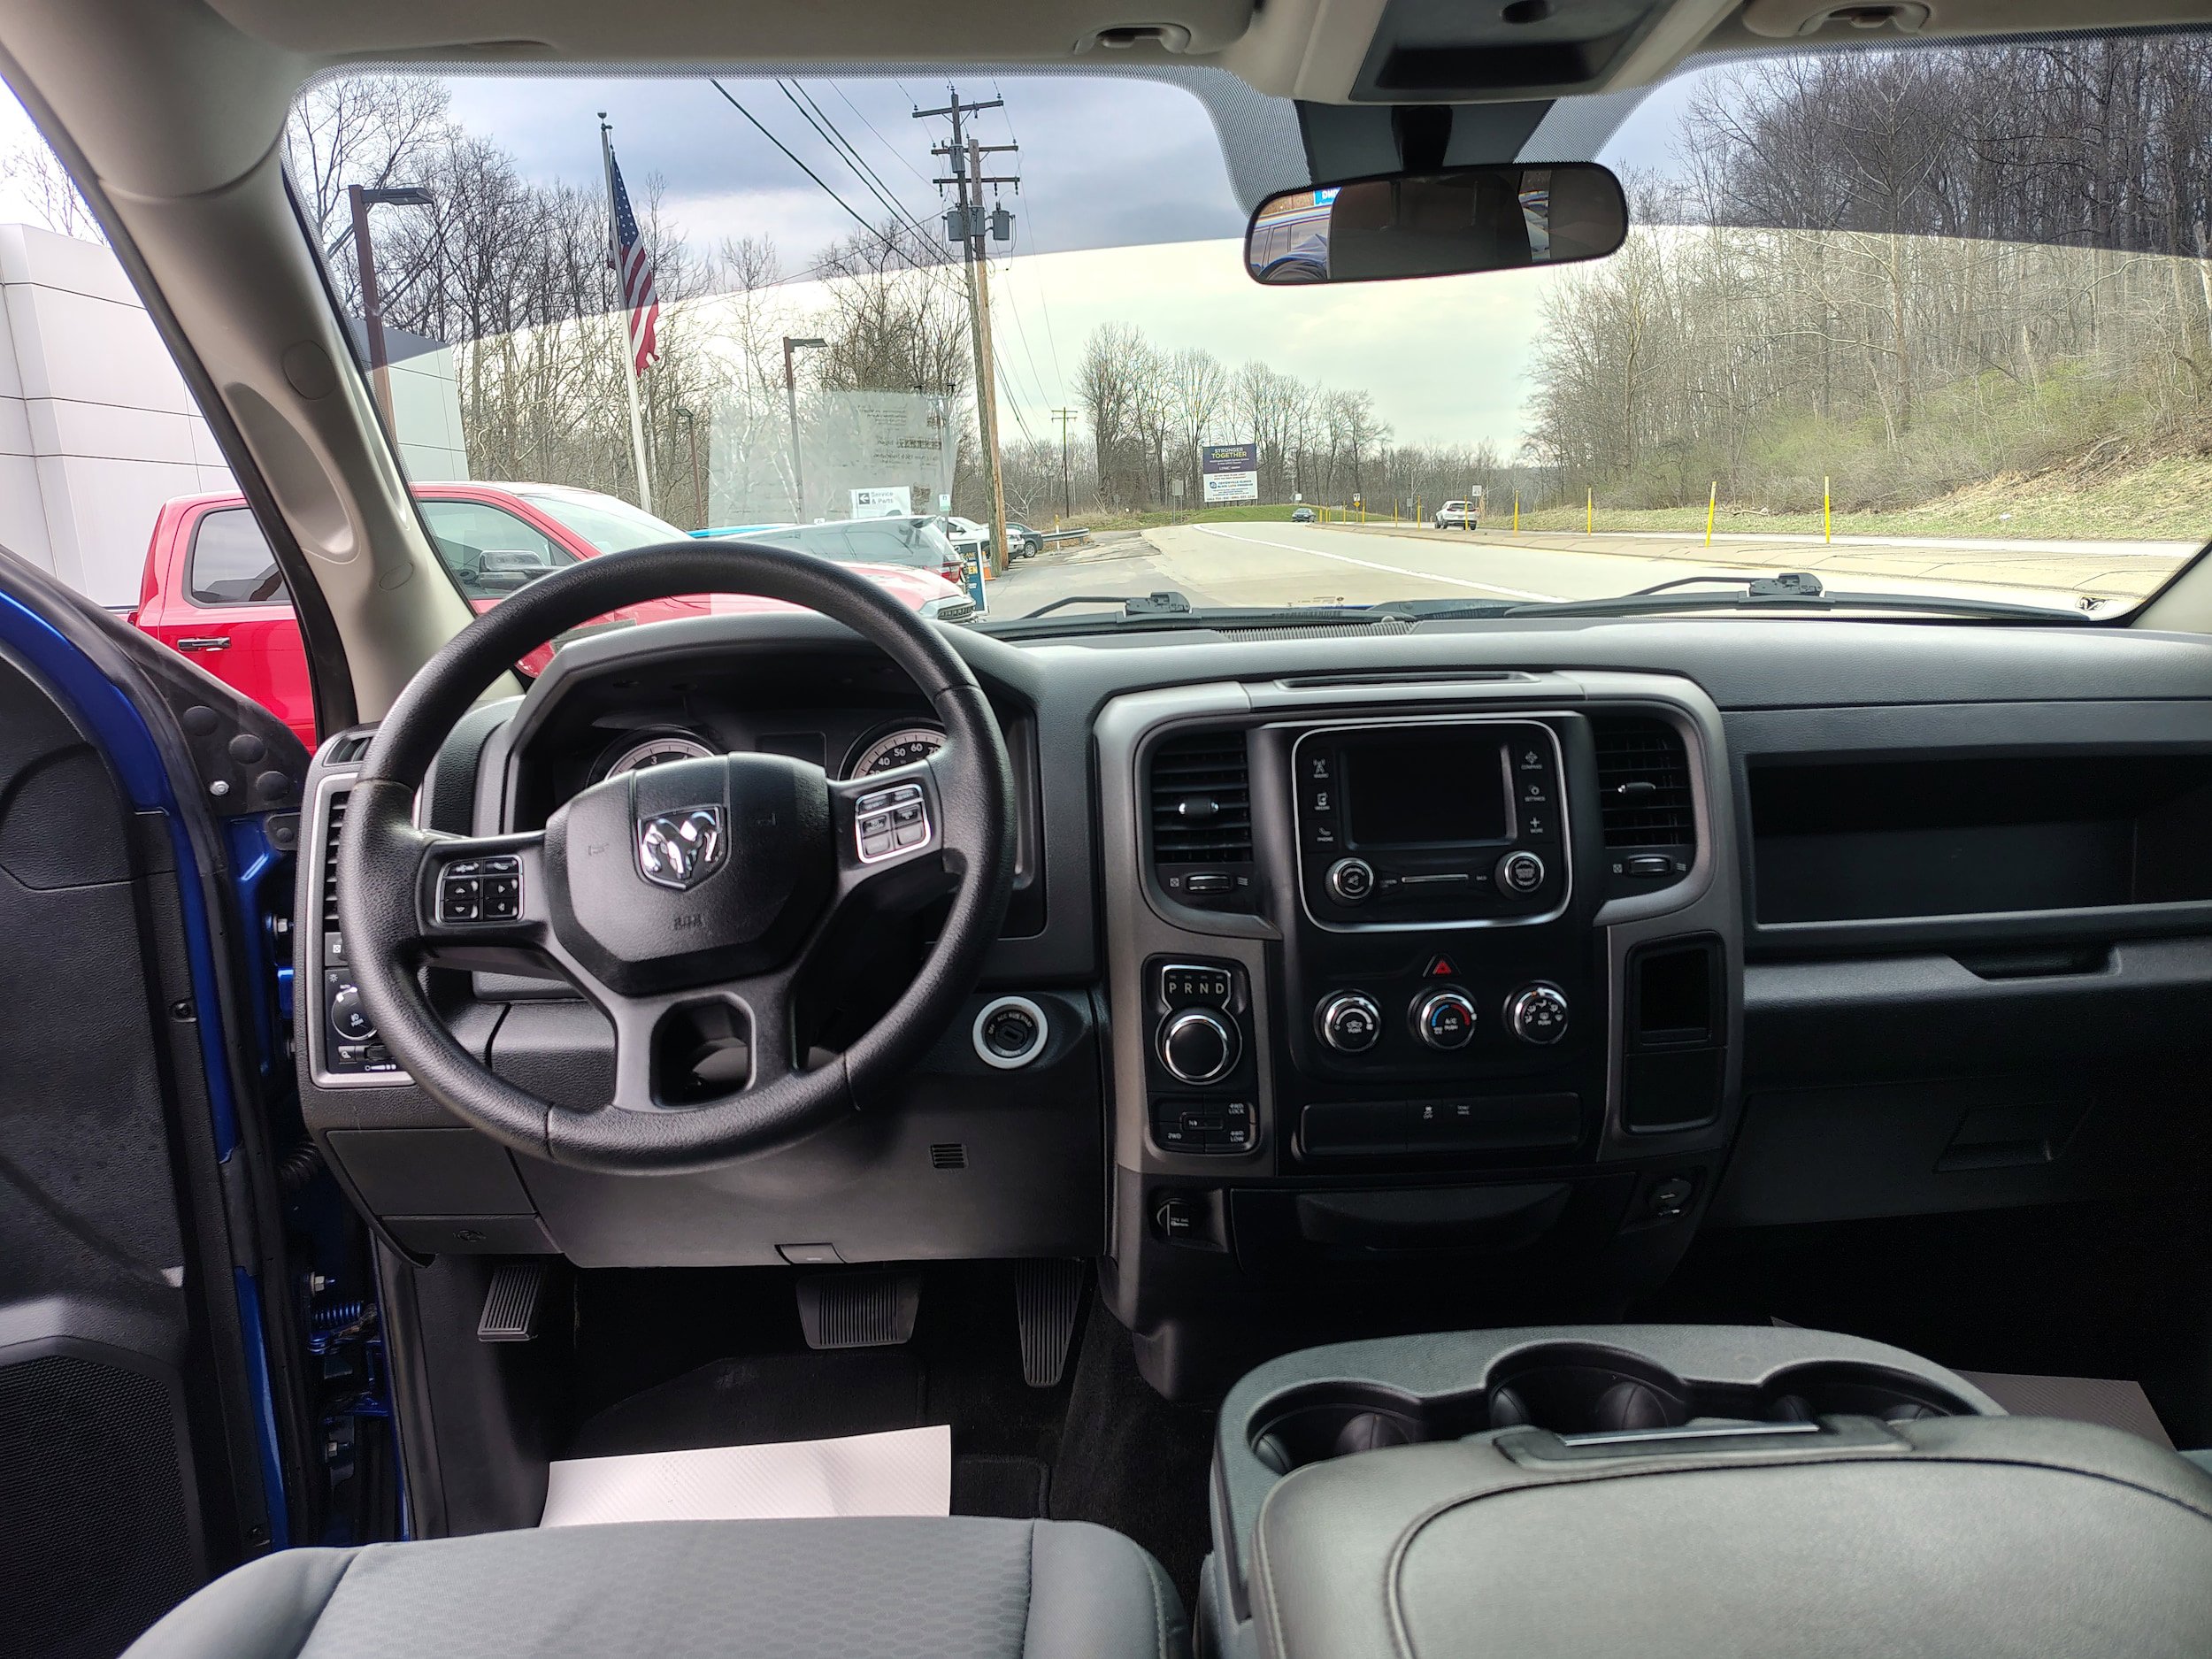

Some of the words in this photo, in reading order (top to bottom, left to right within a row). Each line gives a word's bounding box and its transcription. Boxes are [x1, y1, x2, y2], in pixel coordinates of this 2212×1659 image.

[910, 743, 923, 752] 60
[894, 748, 906, 757] 50
[650, 756, 657, 764] 3
[878, 757, 891, 766] 40
[1169, 982, 1177, 994] P
[1184, 982, 1193, 994] R
[1199, 982, 1209, 994] N
[1215, 982, 1225, 995] D
